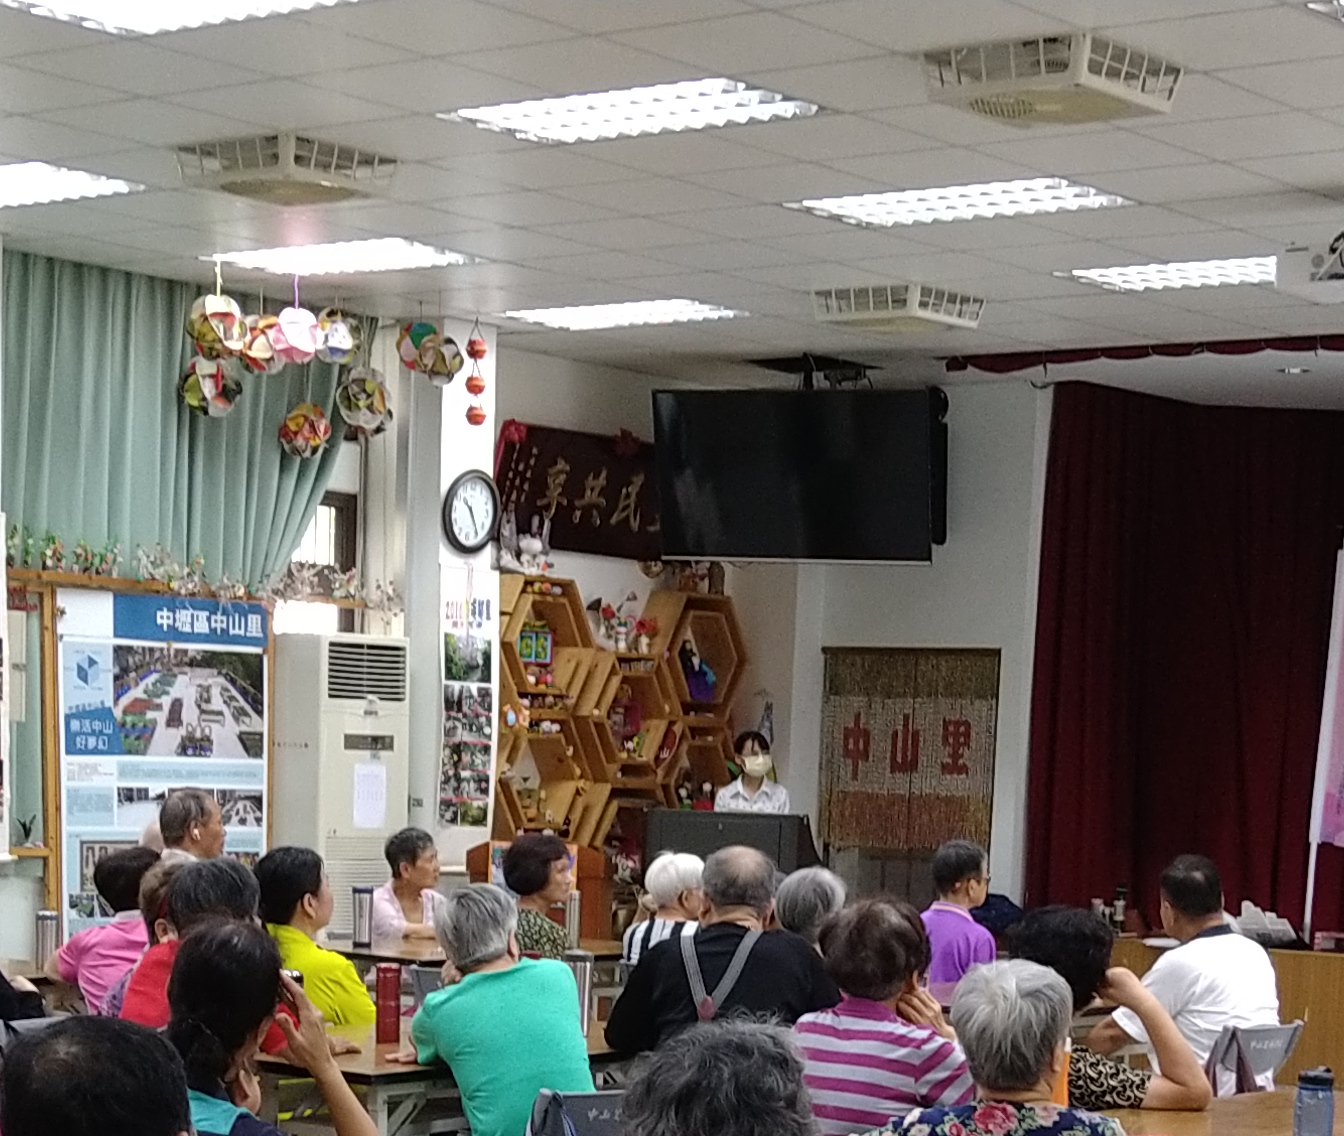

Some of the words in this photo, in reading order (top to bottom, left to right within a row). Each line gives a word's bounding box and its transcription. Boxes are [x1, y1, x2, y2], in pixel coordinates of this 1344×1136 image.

[156, 607, 264, 638] 中壢區中山里
[843, 712, 972, 782] 中山里
